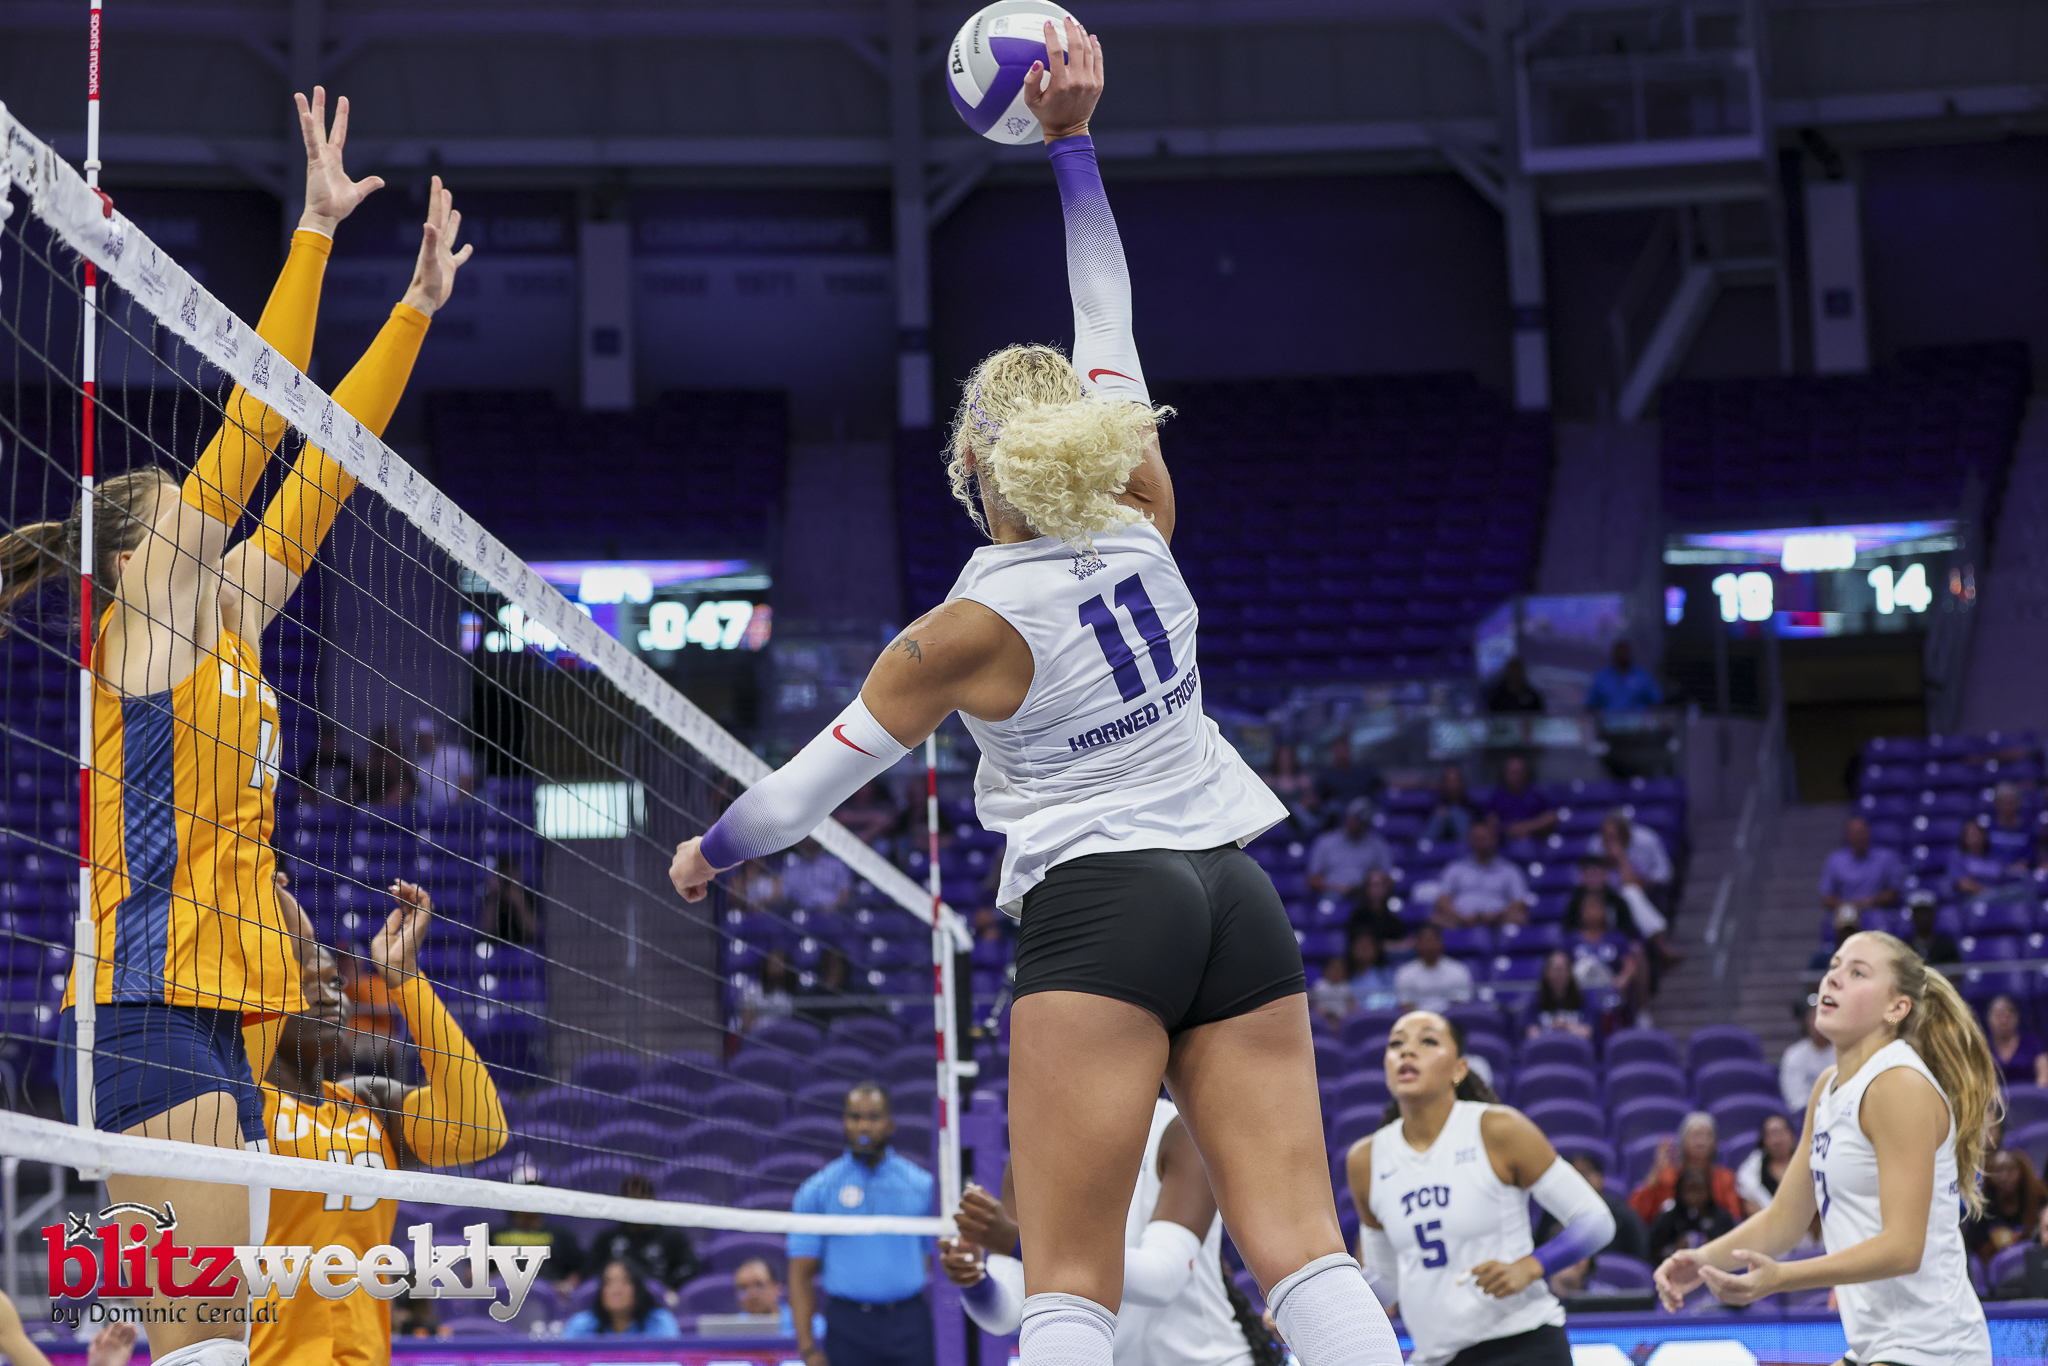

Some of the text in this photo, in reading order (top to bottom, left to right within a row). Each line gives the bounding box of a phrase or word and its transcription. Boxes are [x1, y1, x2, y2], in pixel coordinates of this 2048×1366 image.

[88, 13, 100, 95] sports imports
[1867, 563, 1932, 614] 14
[1078, 572, 1178, 704] 11
[1067, 702, 1160, 752] HORNED
[1401, 1186, 1449, 1216] TCU
[1415, 1220, 1448, 1269] 5
